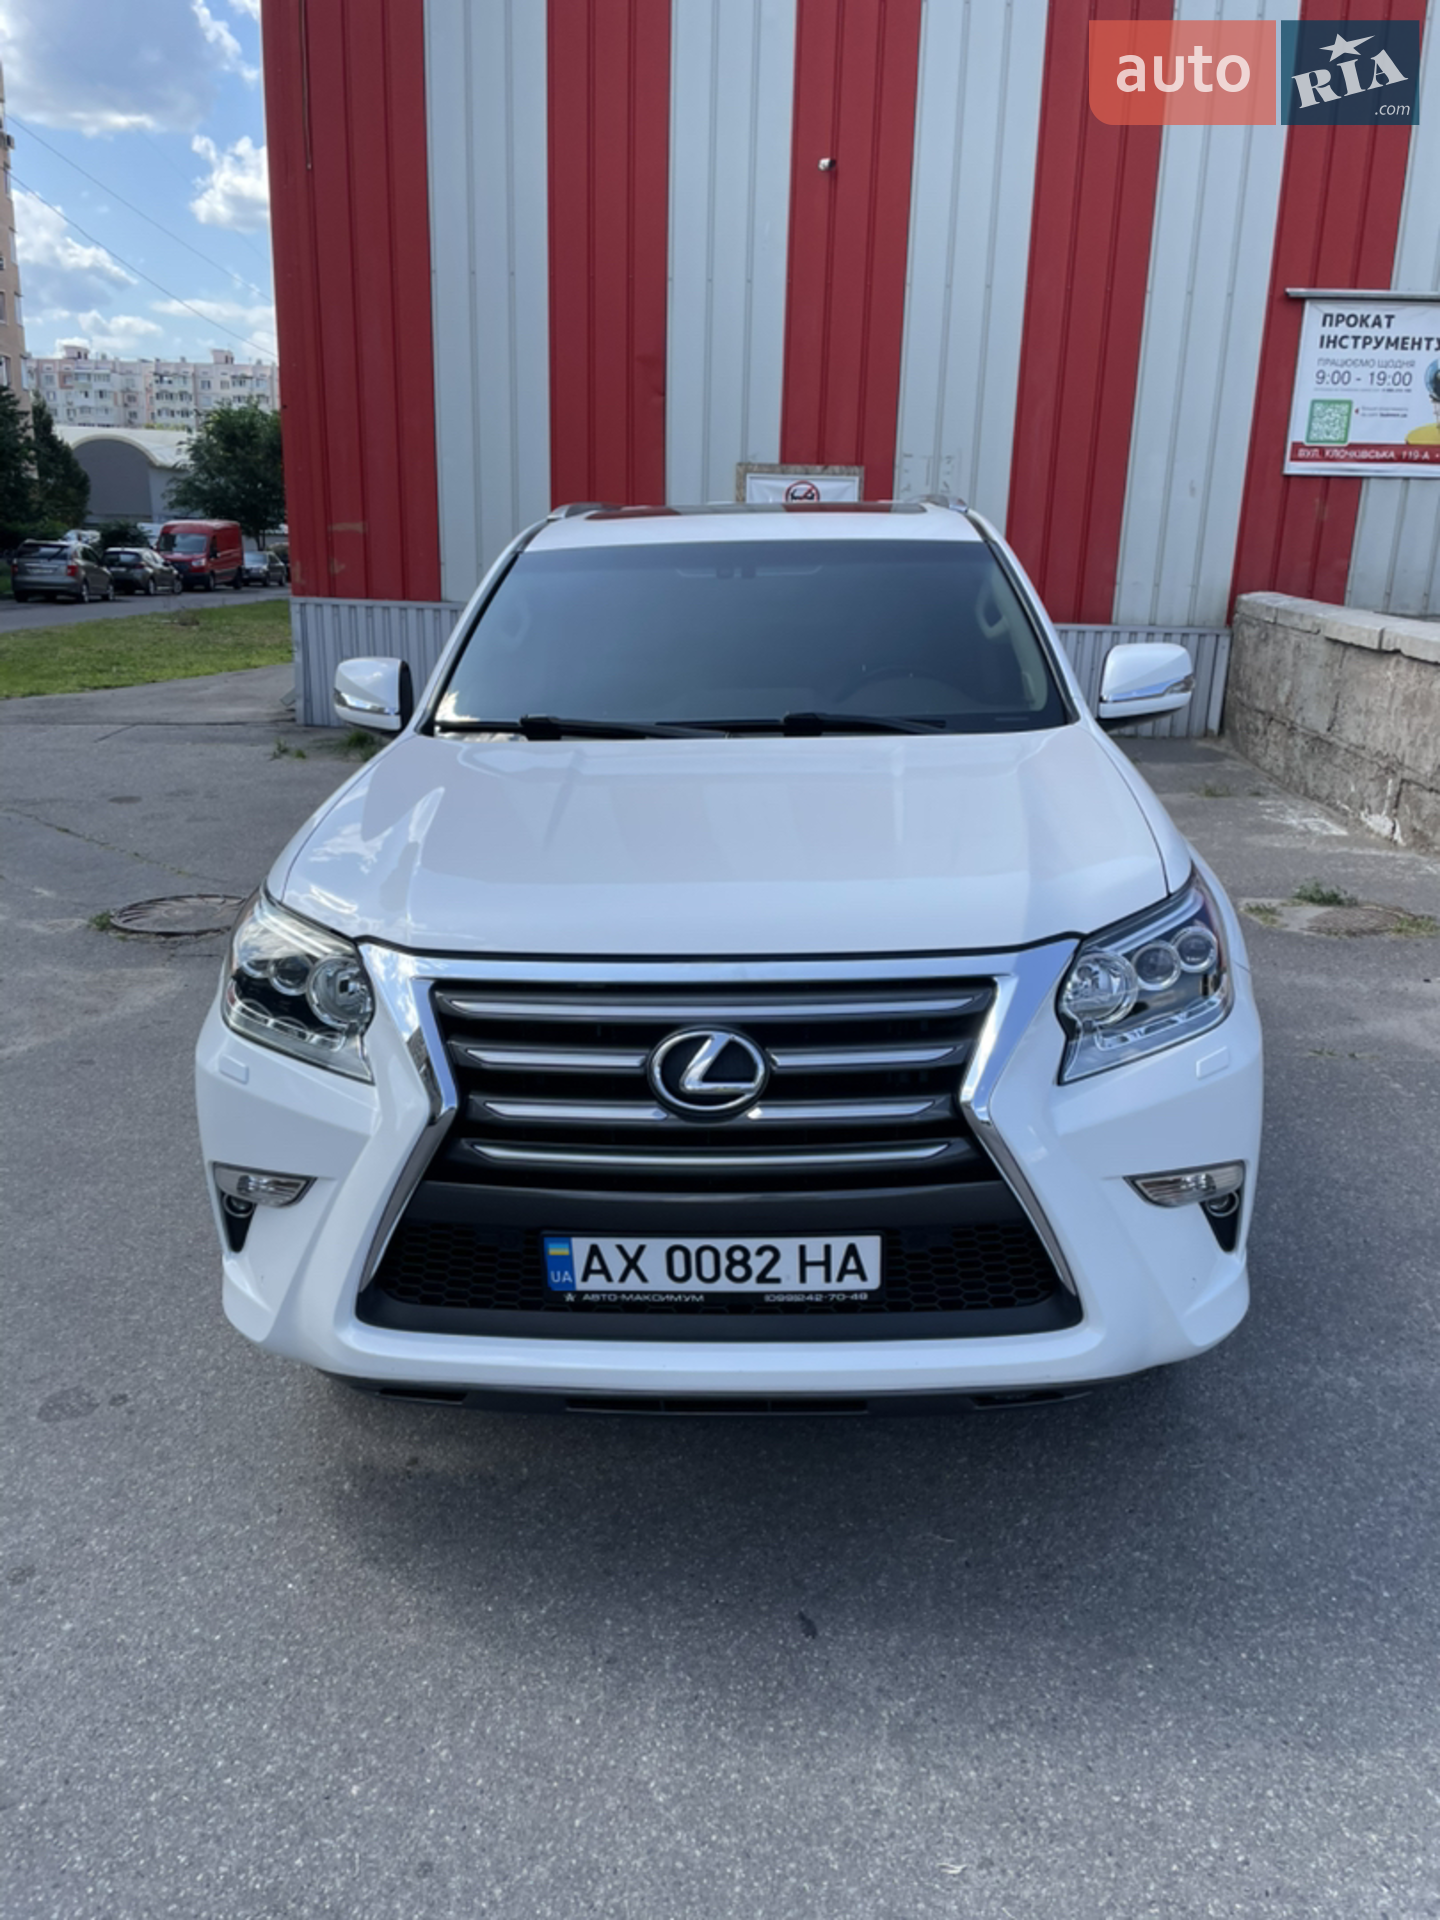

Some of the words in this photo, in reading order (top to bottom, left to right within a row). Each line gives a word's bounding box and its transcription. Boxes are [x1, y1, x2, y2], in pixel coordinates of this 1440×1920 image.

[1321, 312, 1396, 329] ПРОКАТ
[1377, 359, 1416, 369] ЩОДНЯ
[1315, 370, 1352, 385] 9:00
[1369, 371, 1413, 386] 19:00
[581, 1243, 649, 1284] AX
[665, 1243, 782, 1284] 0082
[798, 1242, 868, 1284] HA
[551, 1270, 573, 1283] UA
